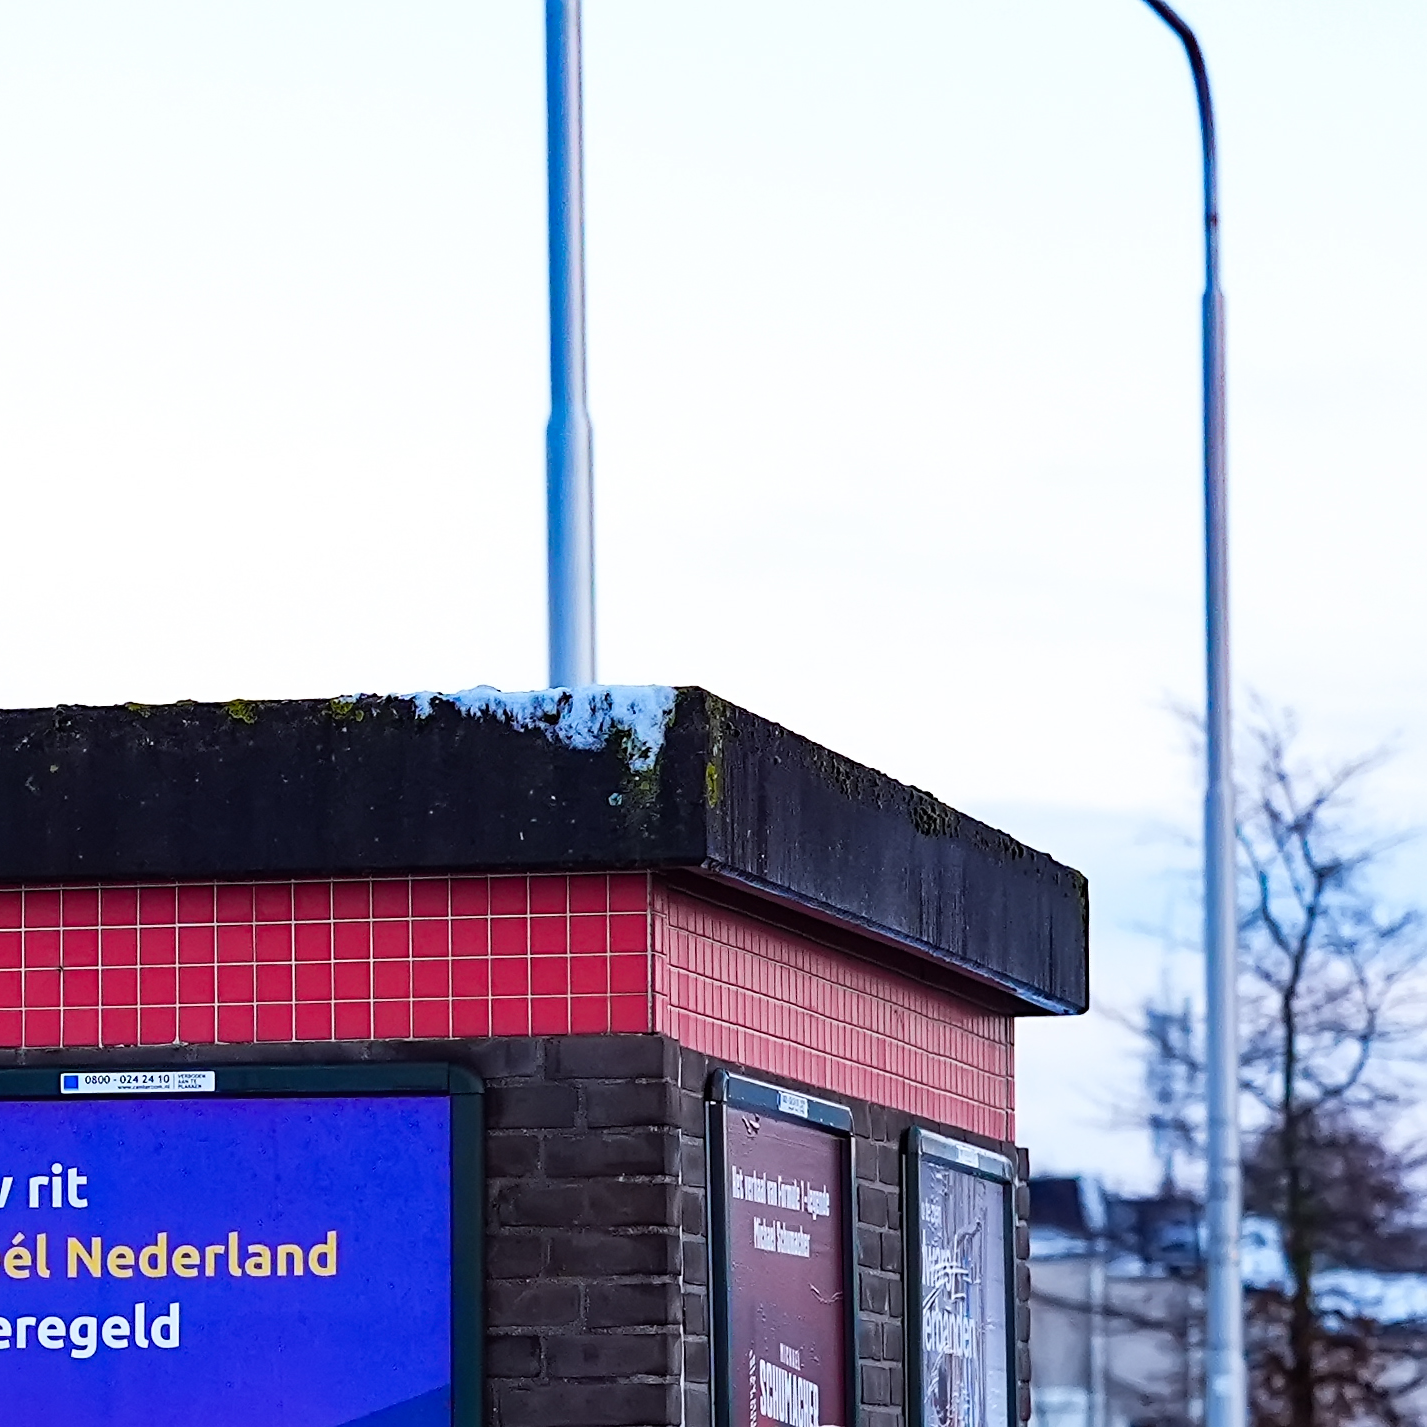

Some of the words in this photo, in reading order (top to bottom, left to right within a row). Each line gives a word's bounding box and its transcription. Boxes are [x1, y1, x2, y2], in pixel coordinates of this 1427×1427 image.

[85, 1075, 110, 1084] 0800
[120, 1075, 139, 1084] 024
[142, 1074, 154, 1083] 24
[158, 1074, 170, 1083] 10
[27, 1163, 88, 1209] rit
[66, 1230, 339, 1280] Nederland
[924, 1301, 976, 1360] erbanden
